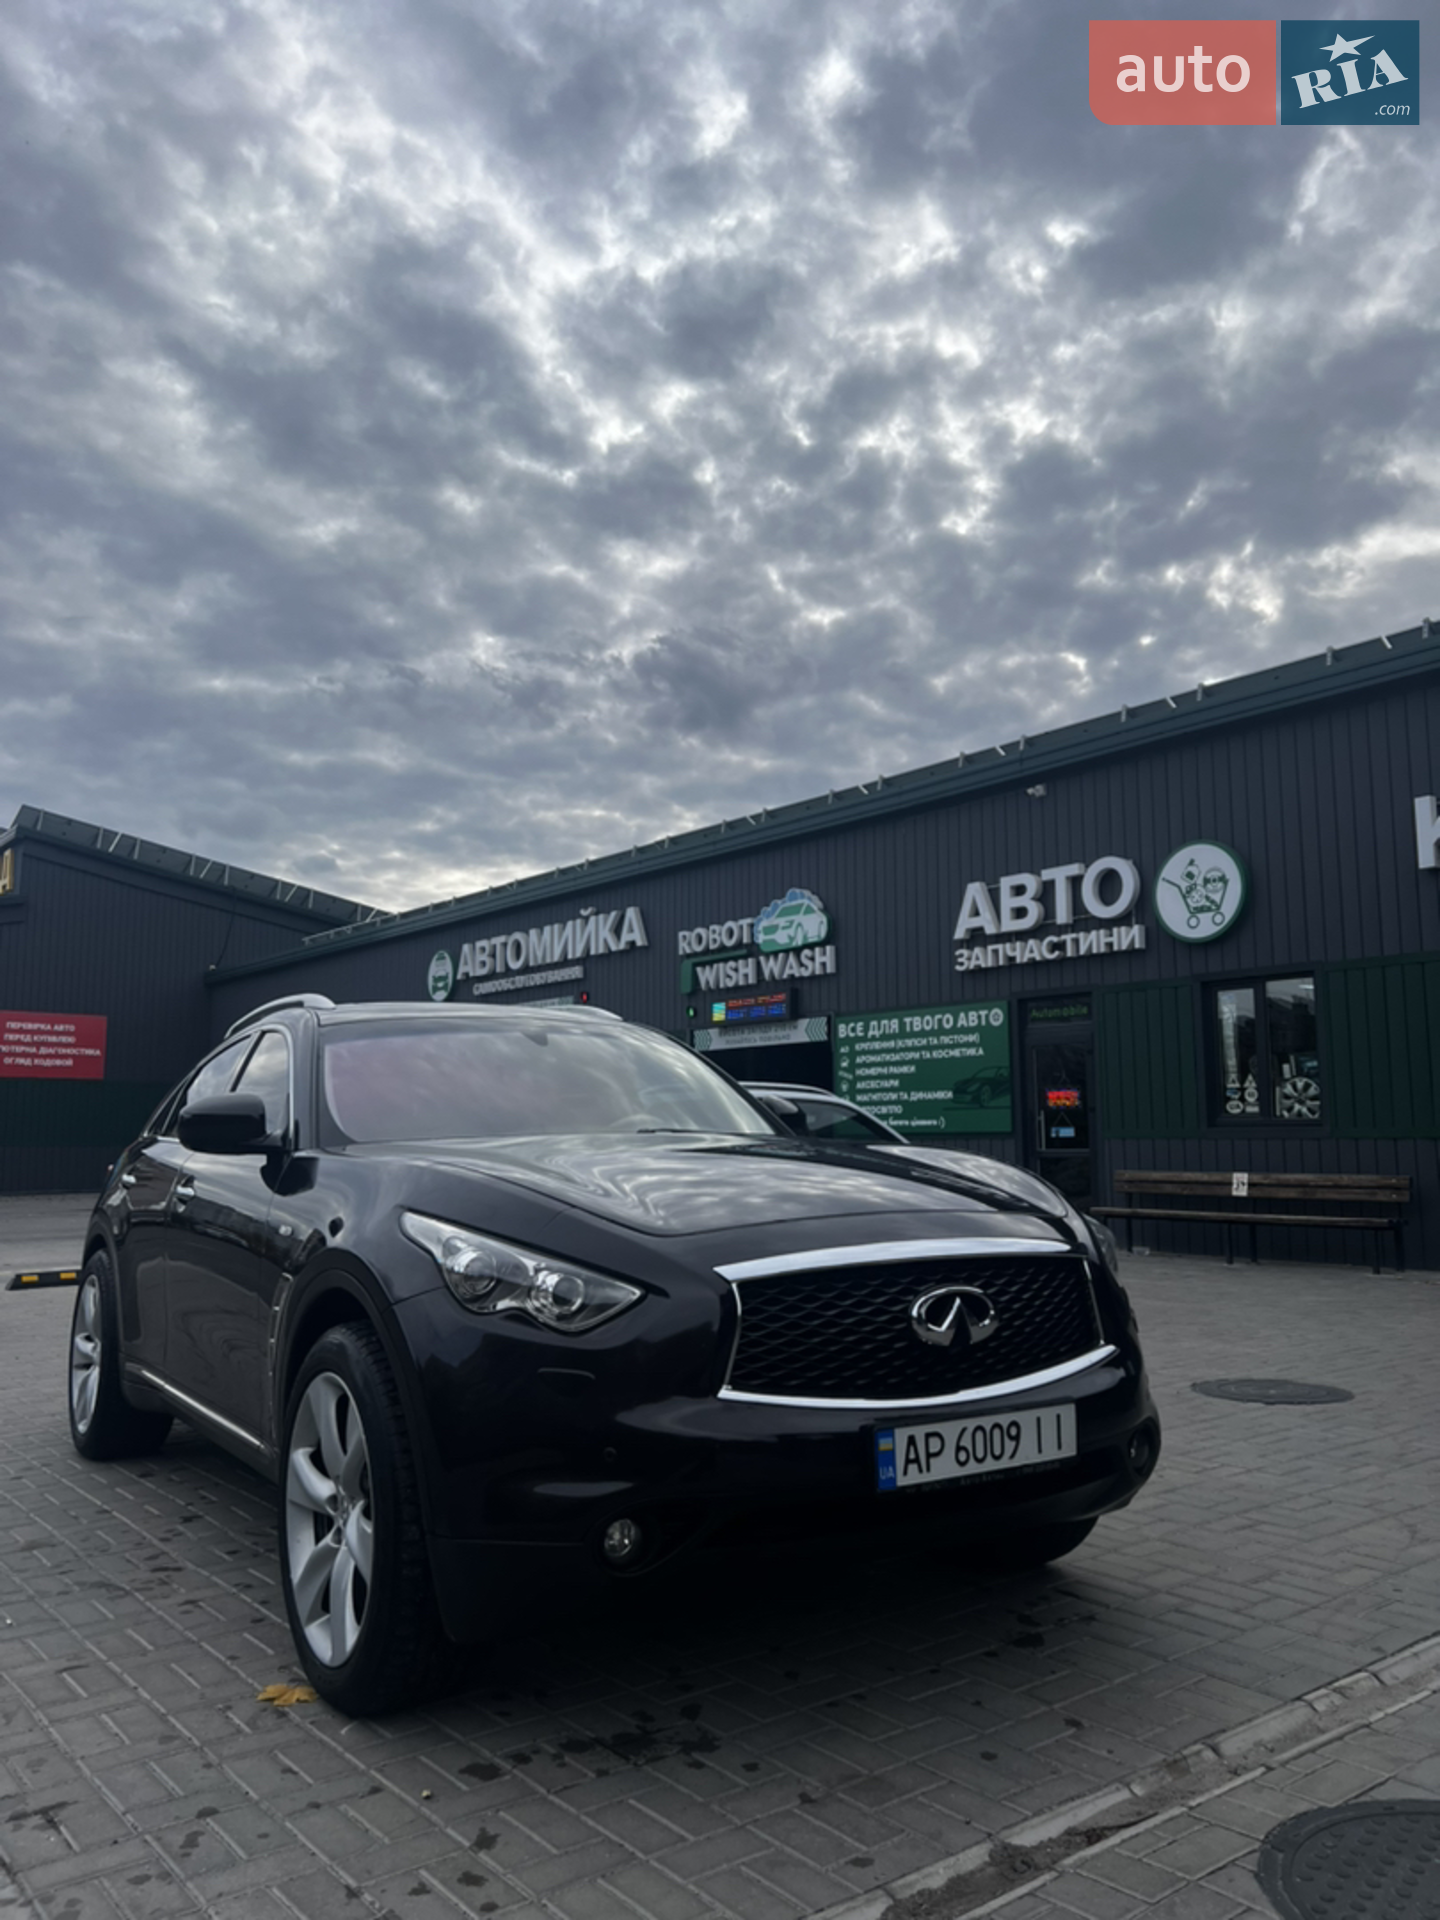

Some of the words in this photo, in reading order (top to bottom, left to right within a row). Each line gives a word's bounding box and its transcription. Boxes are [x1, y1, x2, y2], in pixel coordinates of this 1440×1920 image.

[953, 855, 1141, 940] АВТО
[456, 906, 649, 980] АВТОМИЙКА
[677, 916, 754, 956] ROBOT
[954, 924, 1146, 972] ЗАПЧАСТИНИ
[695, 956, 757, 991] WISH
[758, 945, 836, 983] WASH
[3, 1033, 33, 1043] ПЕРЕД
[53, 1024, 75, 1032] АВТО
[838, 1021, 865, 1038] ВСЕ
[867, 1018, 899, 1038] ДЛЯ
[903, 1013, 953, 1032] ТВОГО
[957, 1007, 1004, 1028] АВТО
[921, 1050, 932, 1059] ТА
[932, 1046, 984, 1059] КОСМЕТИКА
[928, 1037, 938, 1046] ТА
[899, 1091, 908, 1101] ТА
[903, 1430, 946, 1477] AP
[954, 1419, 1022, 1467] 6009
